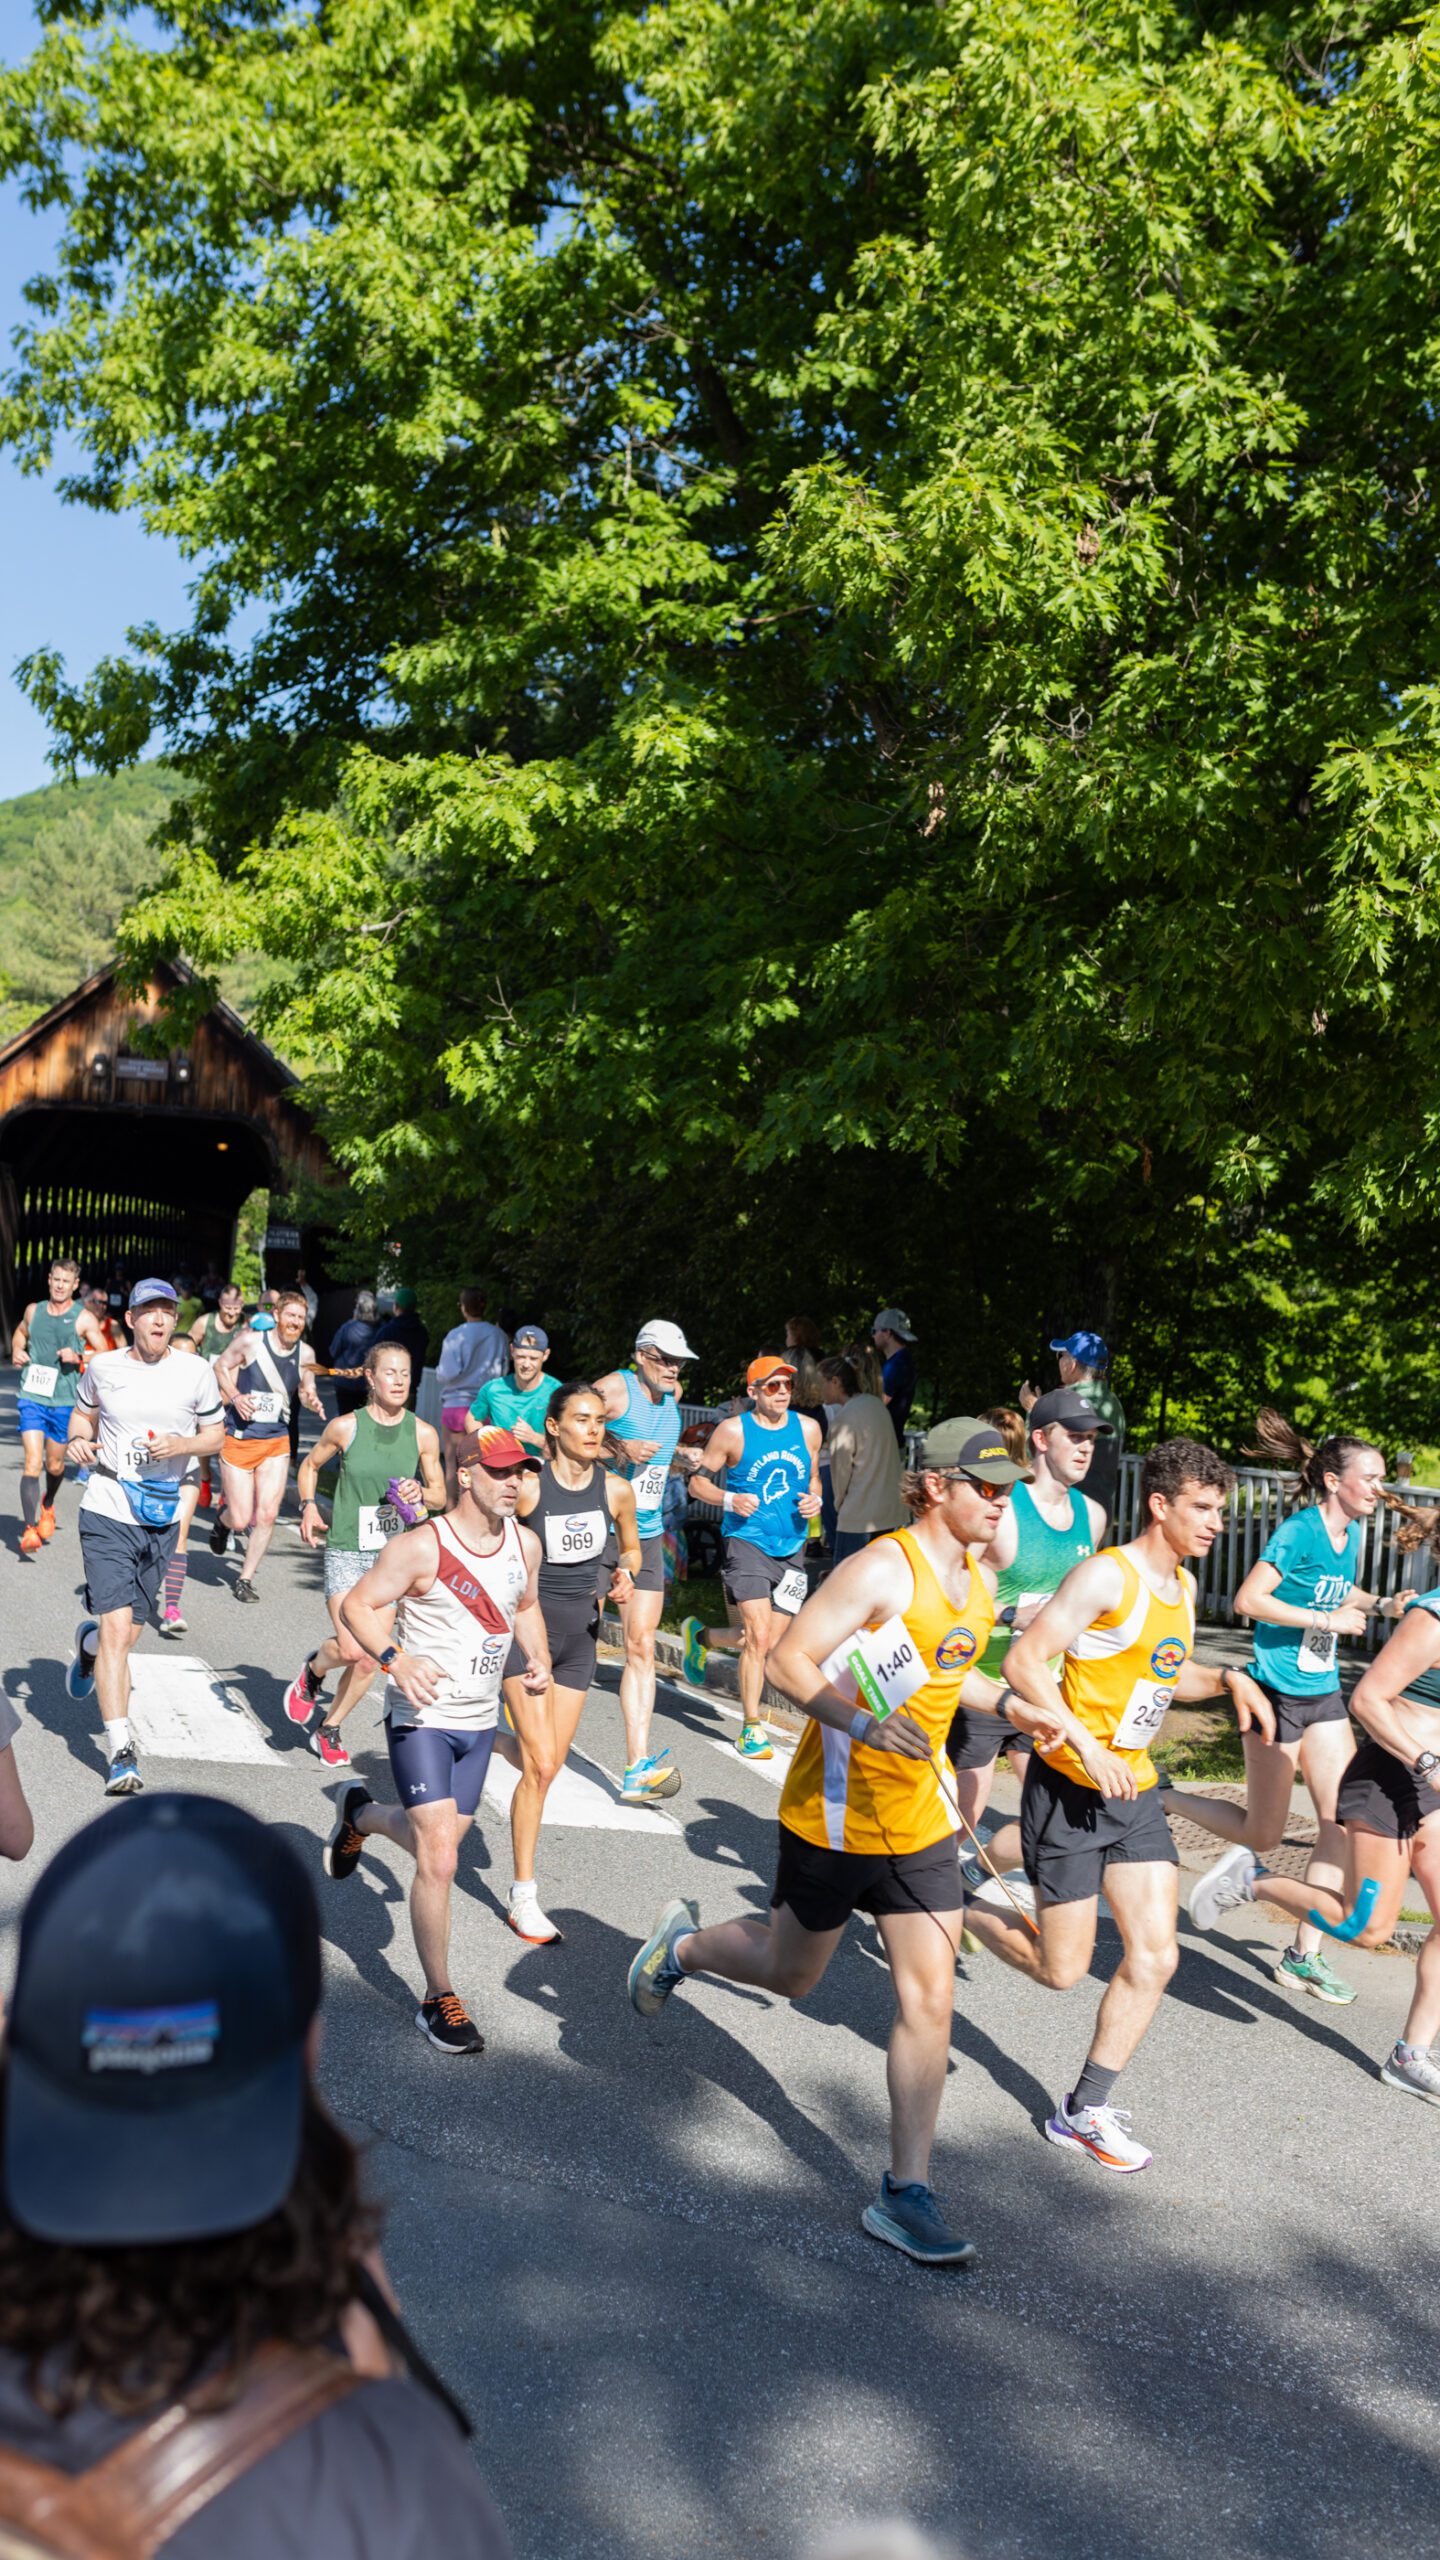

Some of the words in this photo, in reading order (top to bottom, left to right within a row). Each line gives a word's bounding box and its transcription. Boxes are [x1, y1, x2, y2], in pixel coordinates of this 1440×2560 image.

[746, 1450, 780, 1482] PORTLAND
[367, 1517, 399, 1535] 1403
[562, 1532, 593, 1552] 969
[876, 1643, 913, 1683] 1:40
[851, 1655, 868, 1686] GOAL
[866, 1684, 884, 1713] TIME
